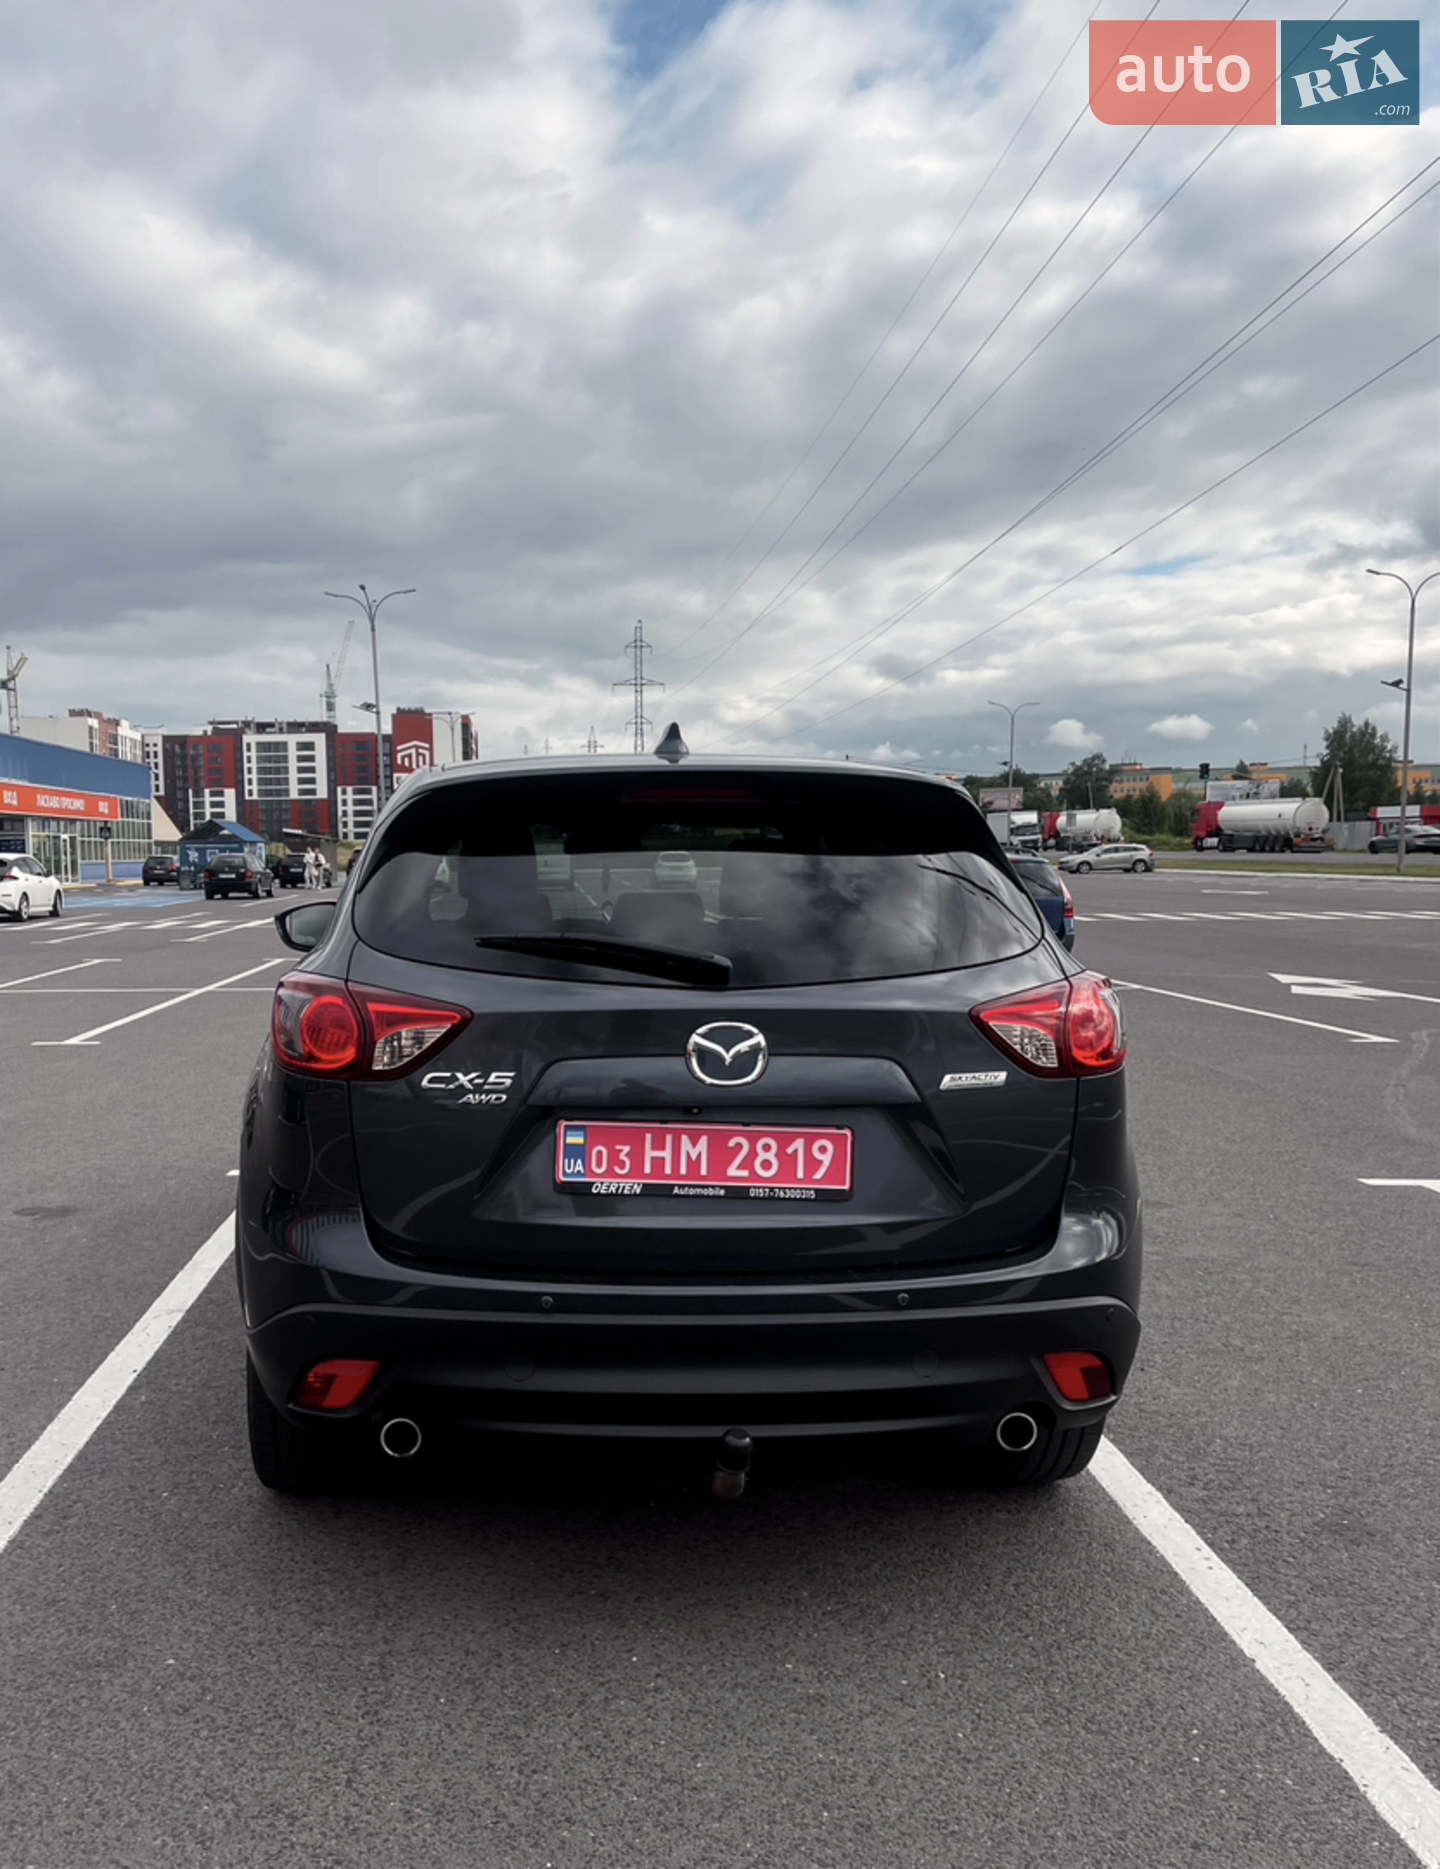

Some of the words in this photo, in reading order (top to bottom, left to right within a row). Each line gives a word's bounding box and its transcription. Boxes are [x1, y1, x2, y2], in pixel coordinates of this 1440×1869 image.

[420, 1071, 517, 1090] CX-5
[949, 1073, 1001, 1082] SKYACTIV
[457, 1093, 508, 1105] AWD
[591, 1145, 631, 1175] 03
[643, 1133, 708, 1176] HM
[726, 1136, 834, 1180] 2819
[564, 1158, 585, 1174] UA
[591, 1183, 643, 1195] OERTEN
[673, 1186, 726, 1197] Automobile
